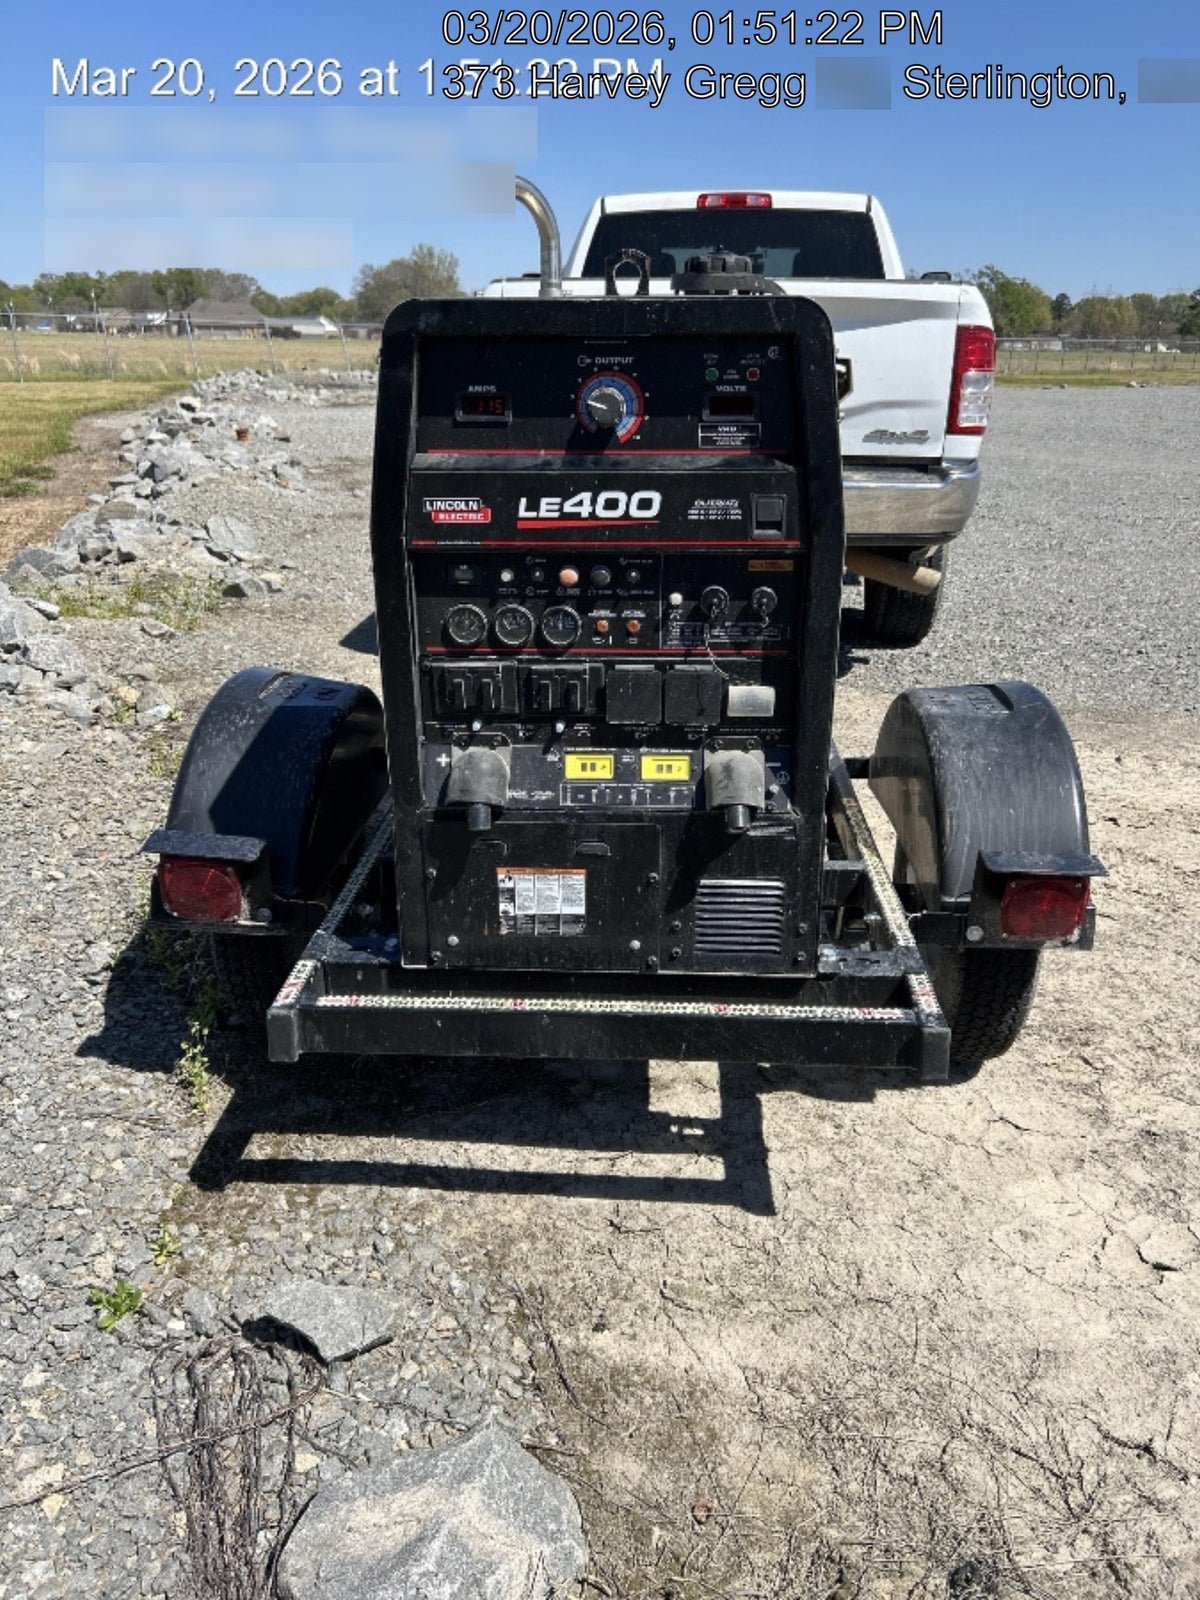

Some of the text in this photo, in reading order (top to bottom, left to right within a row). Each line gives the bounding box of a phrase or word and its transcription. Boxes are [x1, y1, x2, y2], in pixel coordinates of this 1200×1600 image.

[595, 356, 634, 364] OUTPUT
[425, 499, 478, 512] LINCOLN
[517, 490, 663, 518] LE400
[438, 512, 485, 521] ELECTRIC
